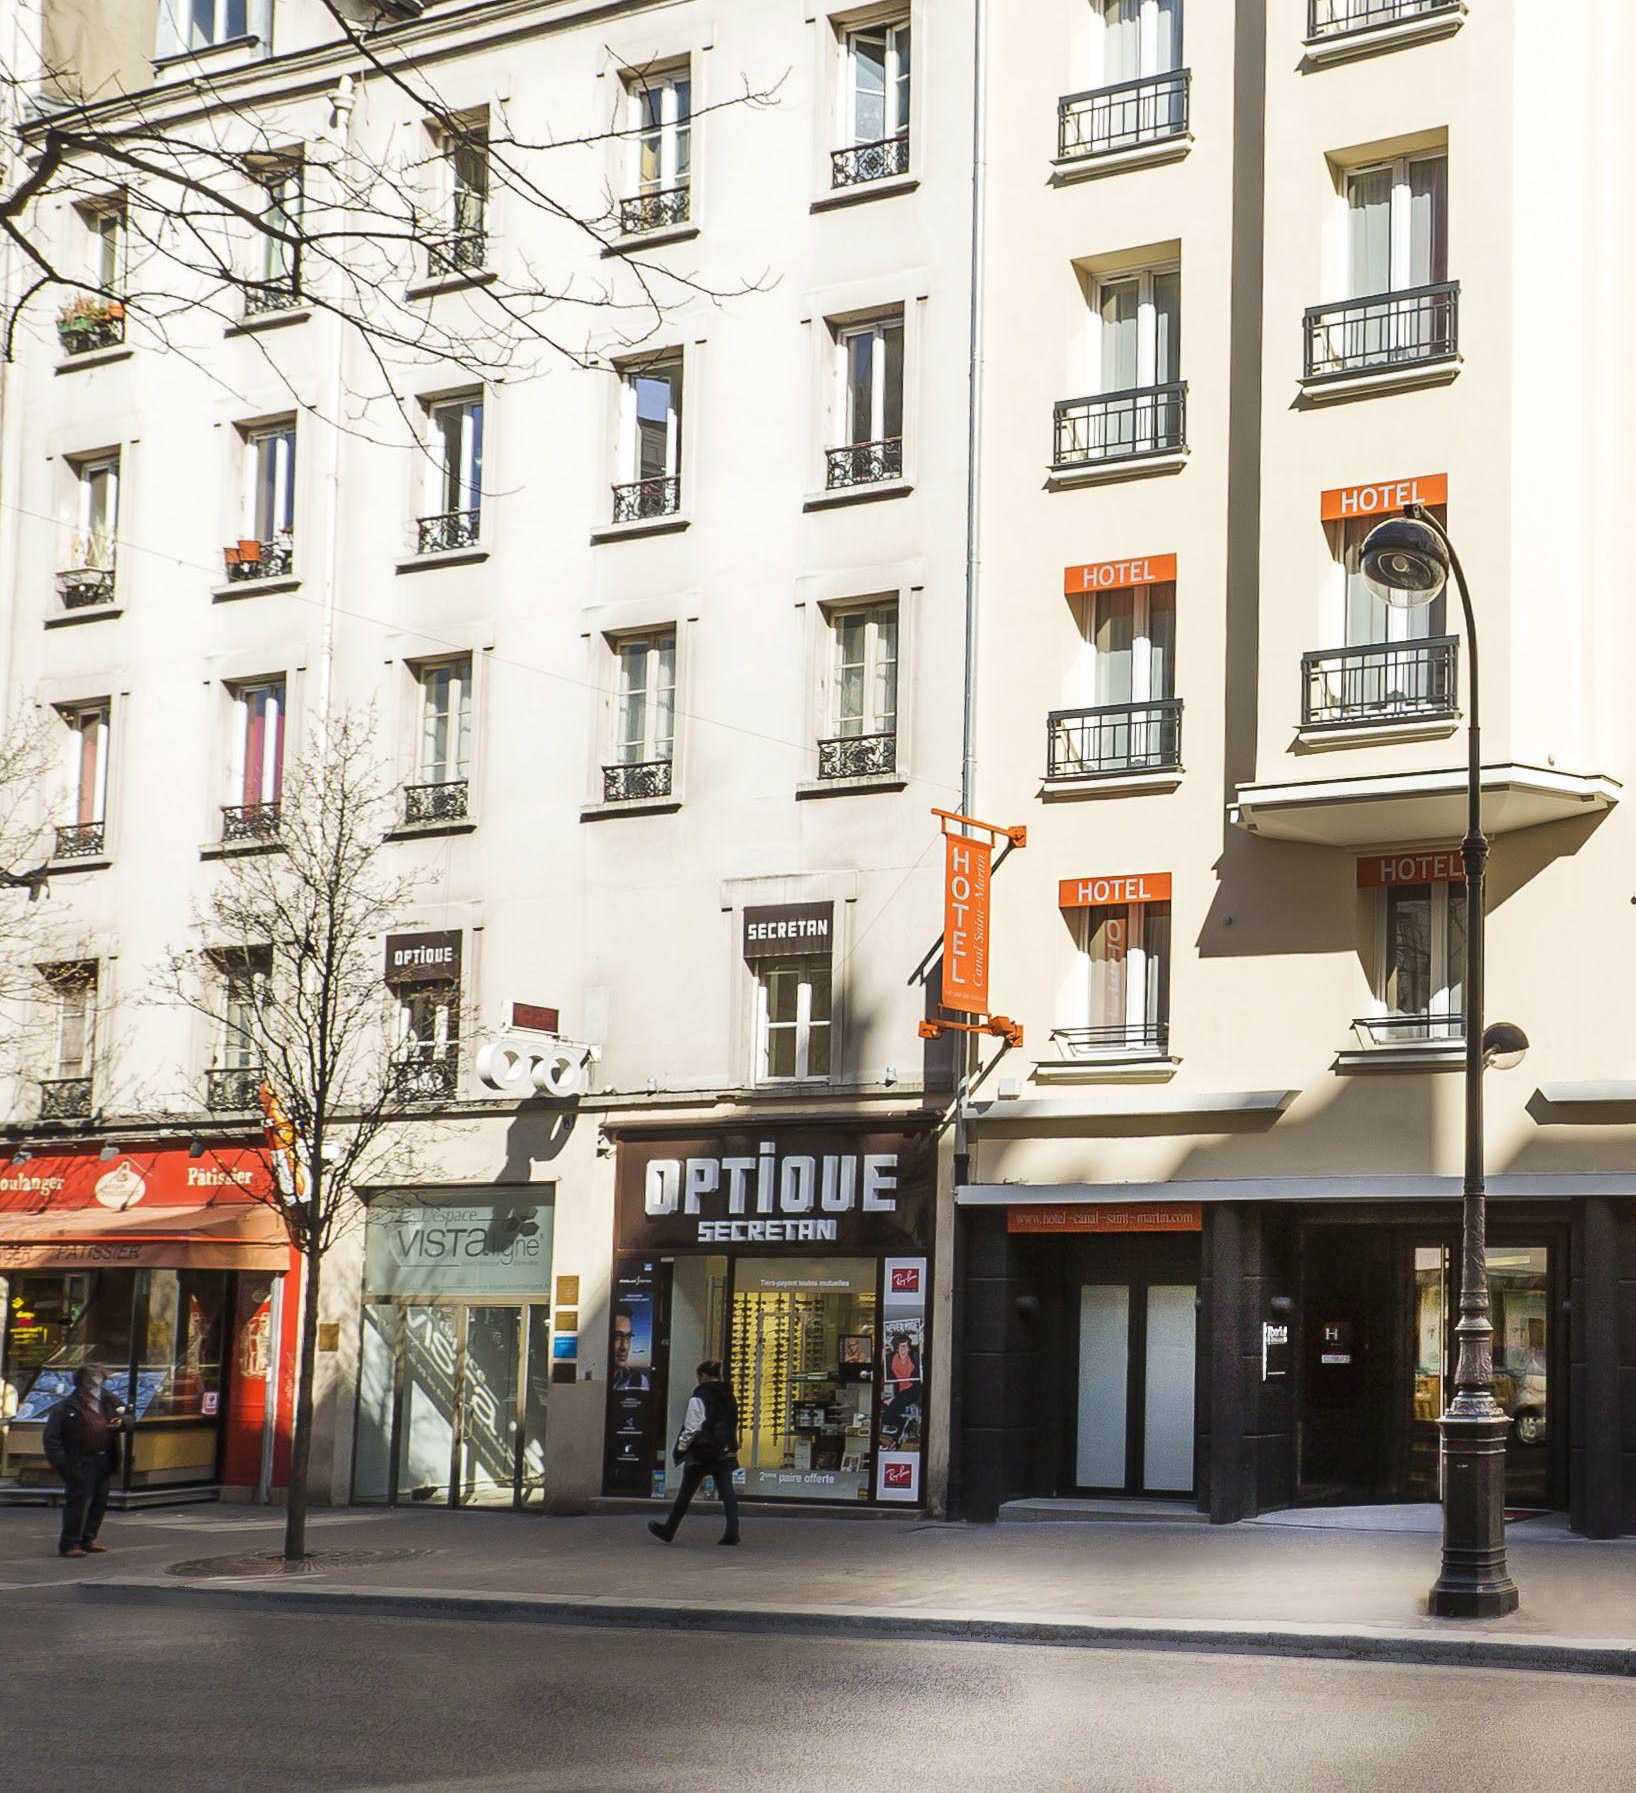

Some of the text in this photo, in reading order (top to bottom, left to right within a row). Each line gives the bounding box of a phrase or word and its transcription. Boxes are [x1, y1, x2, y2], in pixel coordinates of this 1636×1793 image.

[1341, 482, 1426, 515] HOTEL
[1082, 560, 1156, 589] HOTEL
[1381, 855, 1463, 882] HOTEL
[1078, 878, 1151, 902] HOTEL
[951, 847, 970, 984] HOTEL
[747, 920, 828, 940] SECRETAN
[187, 1167, 253, 1187] Pâtissier
[697, 1219, 837, 1242] SECRETAN
